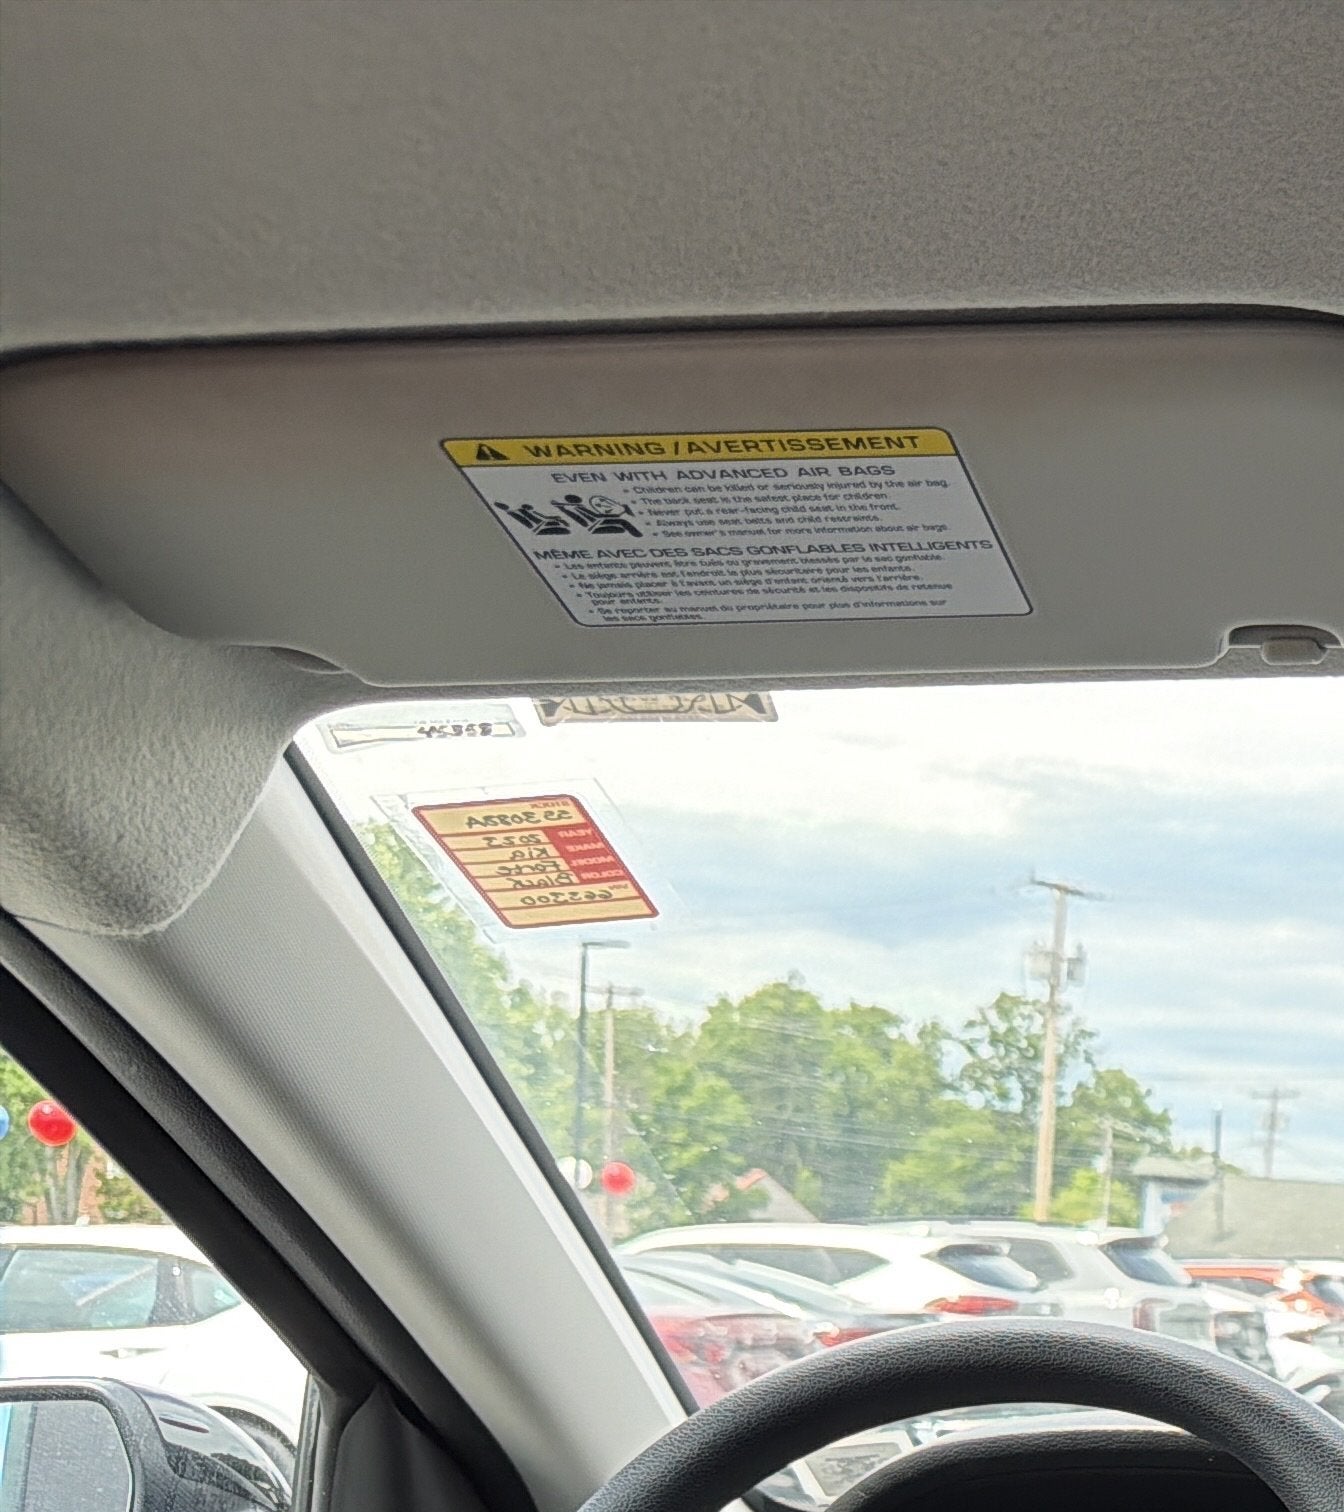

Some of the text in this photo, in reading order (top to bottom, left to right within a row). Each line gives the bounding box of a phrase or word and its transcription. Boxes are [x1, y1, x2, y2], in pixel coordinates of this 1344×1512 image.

[551, 464, 896, 484] EVEN WITH ADVANCED AIR BAGS
[533, 540, 993, 561] MÊME AVEC DES SACS GONFLABLES INTELLIGENTS
